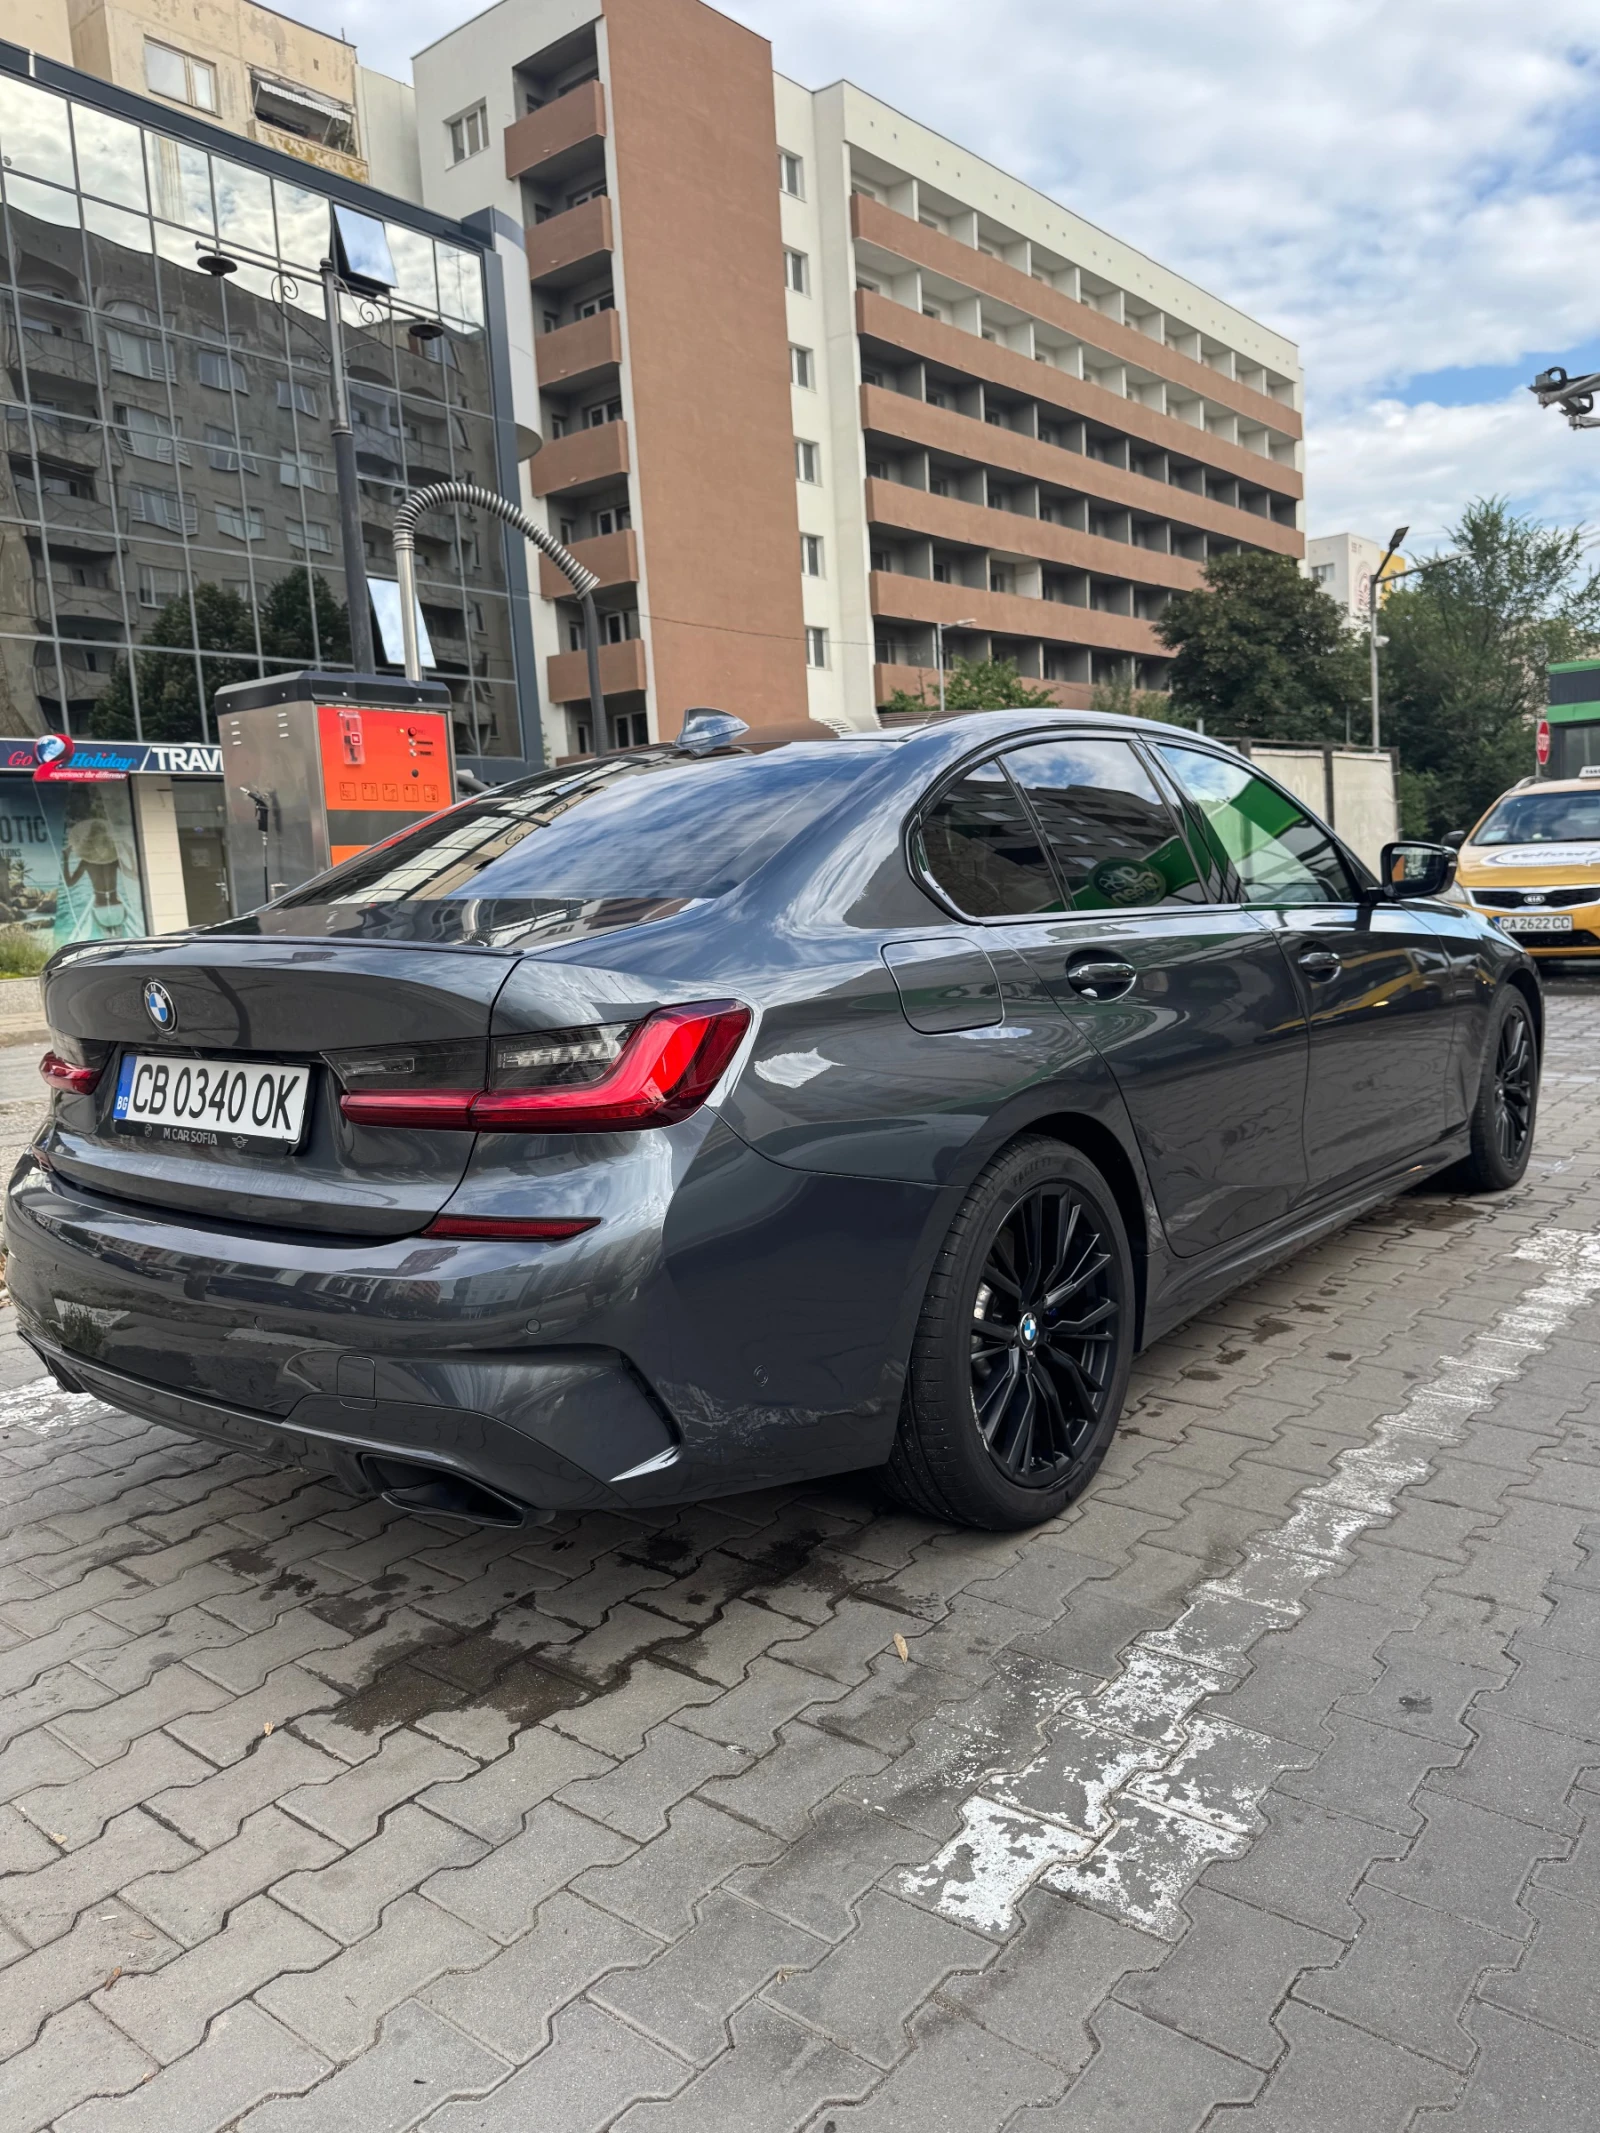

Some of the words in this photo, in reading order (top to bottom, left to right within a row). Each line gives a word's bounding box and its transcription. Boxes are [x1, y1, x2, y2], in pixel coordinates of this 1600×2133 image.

[8, 750, 33, 766] Go
[68, 752, 133, 771] Holiday
[151, 747, 224, 771] TRAV
[50, 770, 84, 780] experience
[85, 770, 95, 778] the
[96, 770, 127, 779] difference
[1501, 918, 1517, 930] CA
[1520, 917, 1550, 930] 2622
[116, 1096, 128, 1110] BG
[133, 1064, 169, 1115] CB
[174, 1067, 247, 1123] 0340
[252, 1074, 300, 1130] OK
[163, 1128, 171, 1139] M
[172, 1129, 190, 1142] CAR
[191, 1131, 217, 1145] SOFIA
